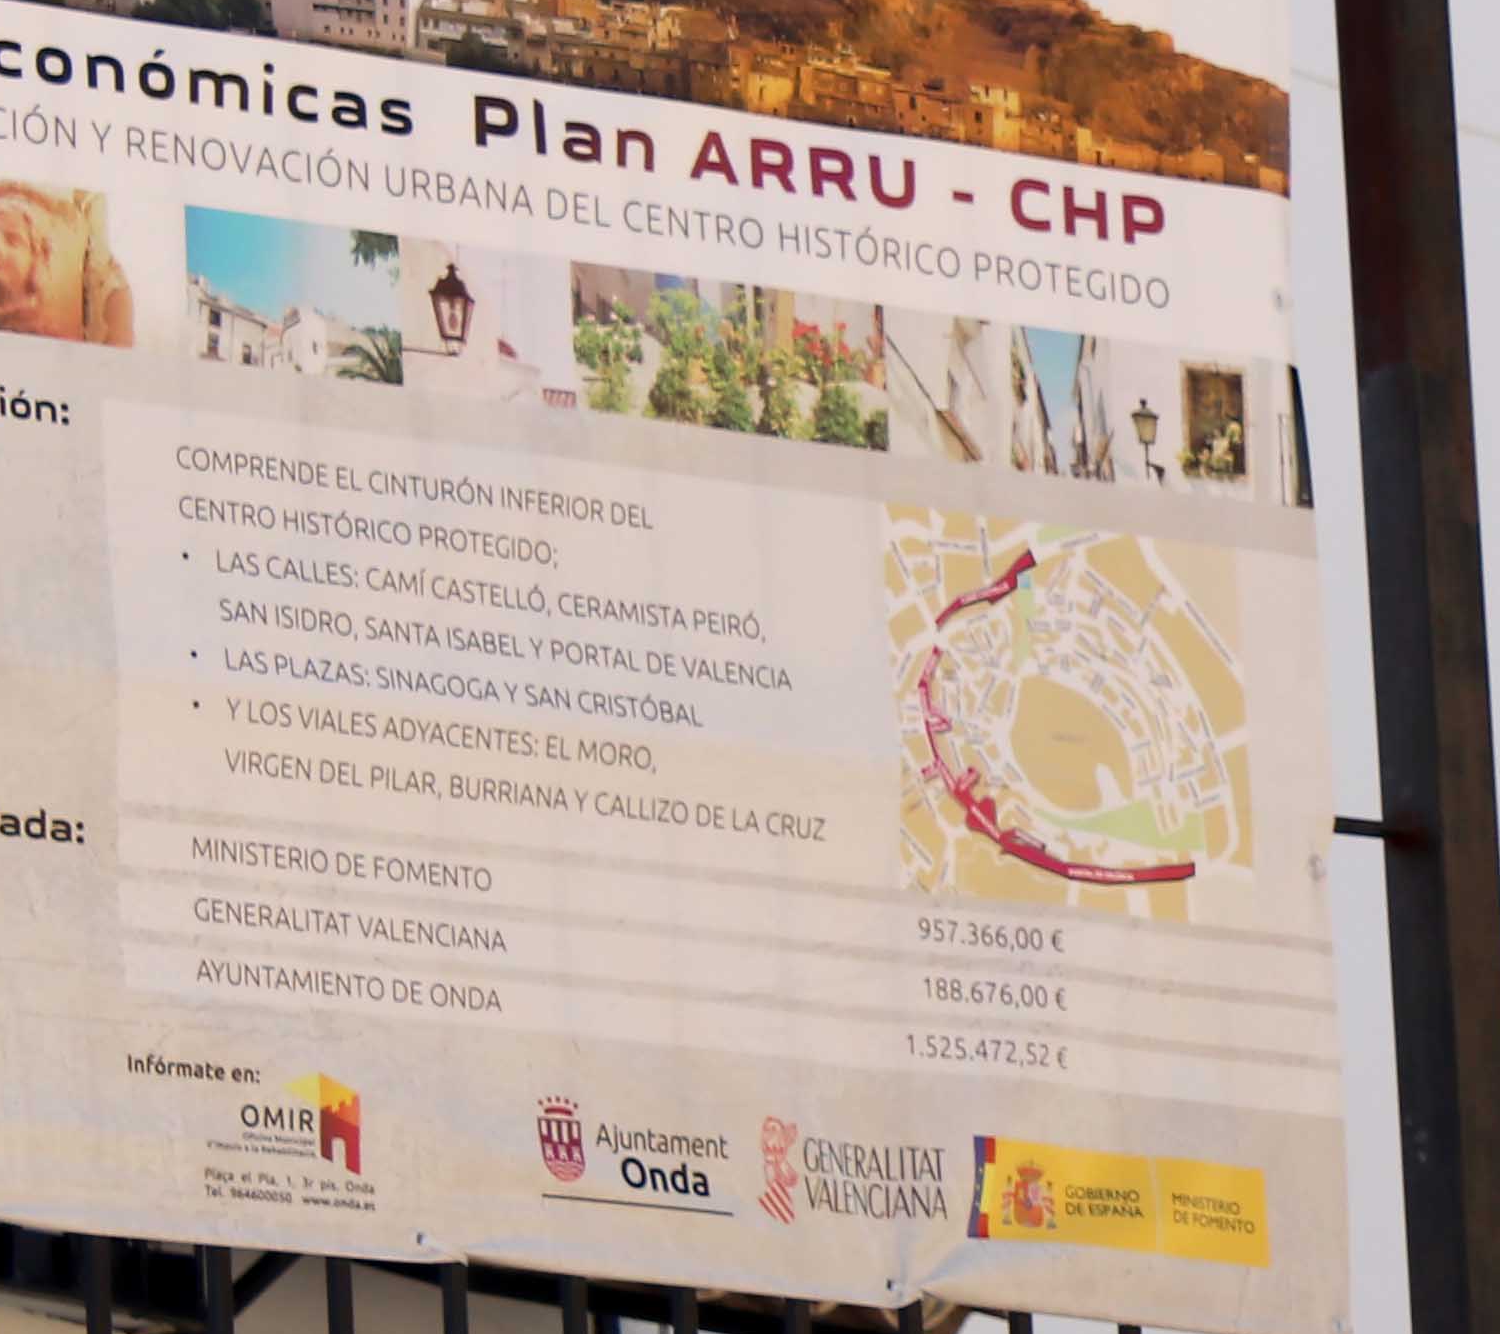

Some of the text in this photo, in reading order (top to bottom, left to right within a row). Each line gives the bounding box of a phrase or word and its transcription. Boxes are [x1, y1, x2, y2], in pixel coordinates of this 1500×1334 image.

[473, 93, 656, 173] Plan
[689, 129, 917, 210] ARRU
[952, 189, 975, 205] -
[1010, 177, 1166, 245] CHP
[90, 121, 113, 155] Y
[126, 126, 370, 192] RENOVACIÓN
[385, 165, 534, 218] URBANA
[546, 188, 611, 229] DEL
[623, 200, 765, 250] CENTRO
[778, 220, 961, 280] HISTÓRICO
[973, 251, 1171, 310] PROTEGIDO
[176, 445, 655, 530] COMPRENDE EL CINTURÓN INFERIOR DEL
[178, 494, 558, 570] CENTRO HISTÓRICO PROTEGIDO;
[216, 548, 767, 645] LAS CALLES: CAMÍ CASTELLÓ, CERAMISTA PEIRÓ,
[219, 597, 793, 692] SAN ISIDRO, SANTA ISABEL Y PORTAL DE VALENCIA
[224, 647, 704, 728] LAS PLAZAS: SINAGOGA Y SAN CRISTÓBAL
[226, 696, 657, 774] Y LOS VIALES ADYACENTES: EL MORO,
[224, 747, 827, 842] VIRGEN DEL PILAR, BURRIANA Y CALLIZO DE LA CRUZ
[191, 835, 493, 893] MINISTERIO DE FOMENTO
[193, 896, 508, 953] GENERALITAT VALENCIANA
[917, 916, 1066, 954] 957.366,00 €
[196, 958, 503, 1013] AYUNTAMIENTO DE ONDA
[923, 976, 1069, 1012] 188.676,00 €
[127, 1053, 261, 1084] Infórmate en:
[906, 1033, 1069, 1069] 1.525.472,52 €
[240, 1103, 315, 1133] OMIR
[596, 1122, 729, 1160] Ajuntament
[803, 1137, 946, 1182] GENERALITAT
[204, 1166, 236, 1184] Plaça
[240, 1170, 253, 1184] el
[345, 1180, 376, 1196] Onda
[204, 1183, 223, 1199] Tel.
[301, 1194, 376, 1212] www.onda.es
[620, 1156, 710, 1197] Onda
[804, 1174, 949, 1220] VALENCIANA
[1065, 1184, 1140, 1204] GOBIERNO
[1065, 1202, 1084, 1217] DE
[1171, 1192, 1241, 1216] MINISTERIO
[1172, 1209, 1256, 1235] DE FOMENTO
